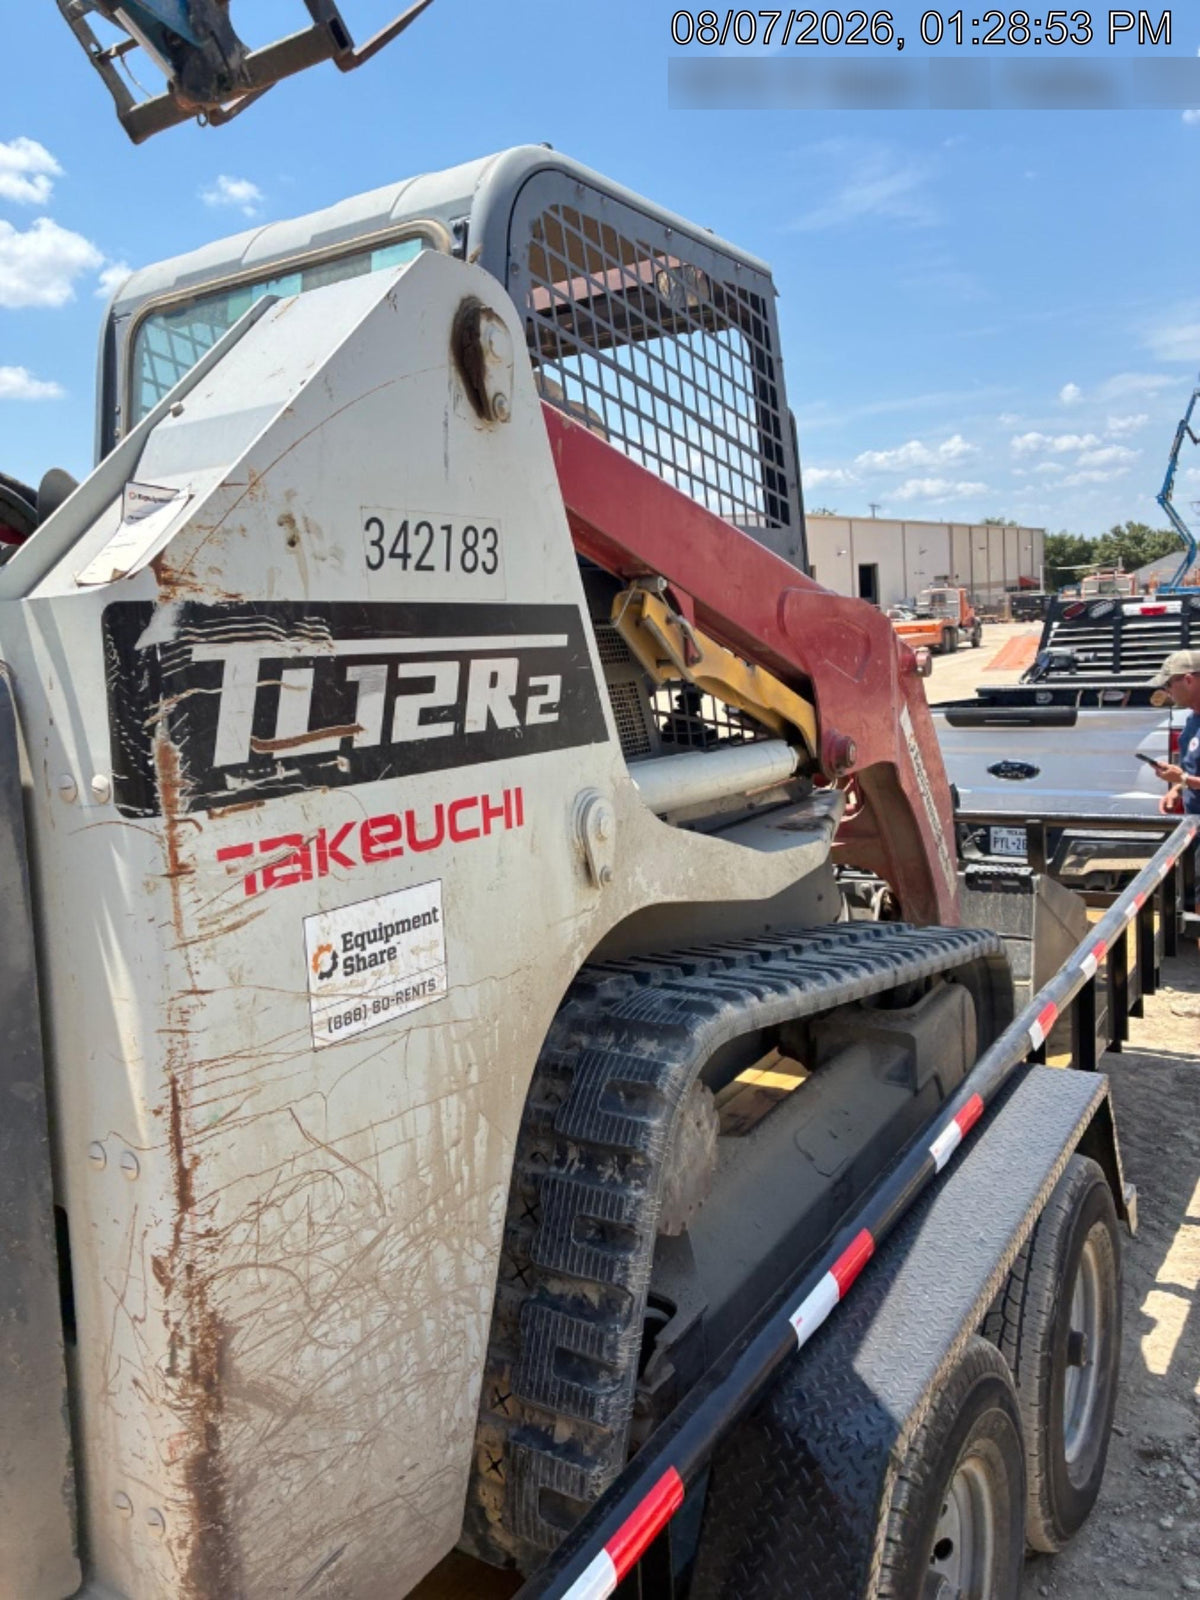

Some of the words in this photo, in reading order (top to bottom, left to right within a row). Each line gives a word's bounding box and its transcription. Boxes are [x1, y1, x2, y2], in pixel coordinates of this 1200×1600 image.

[363, 516, 500, 575] 342183
[341, 906, 439, 953] Equipment
[342, 946, 398, 977] Share
[327, 1004, 368, 1034] (888)
[372, 978, 437, 1014] 80-RENTS
